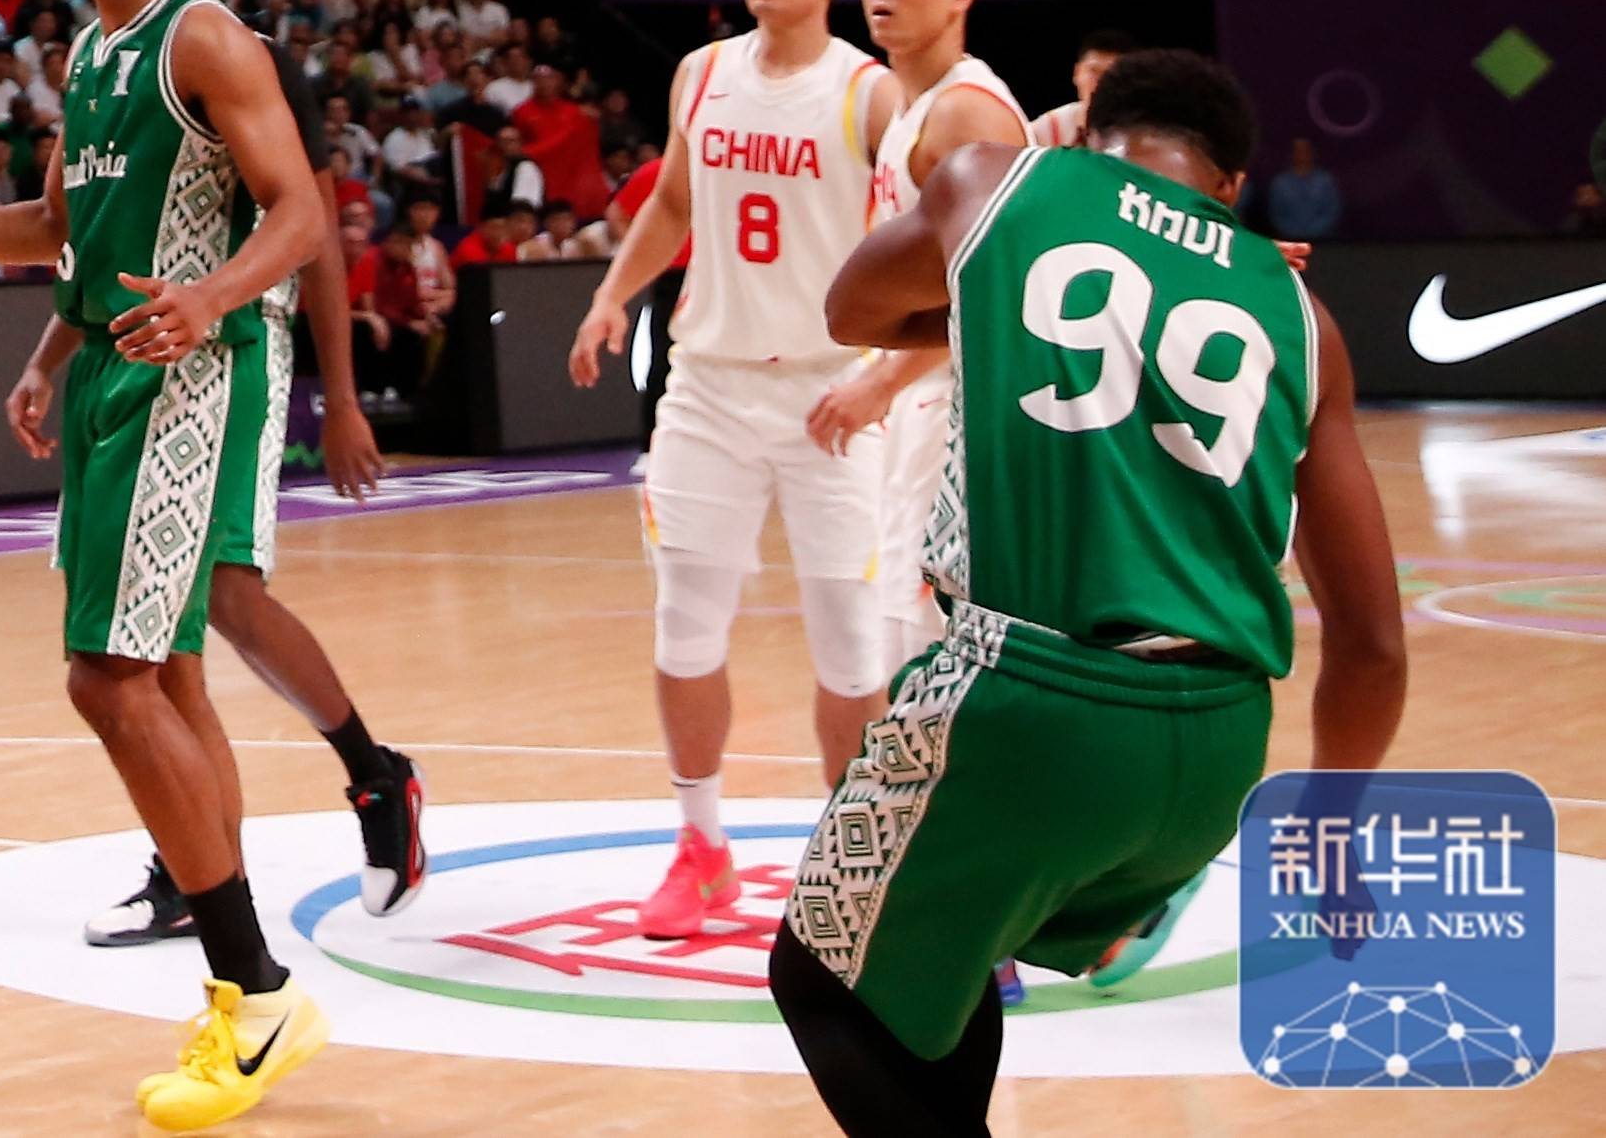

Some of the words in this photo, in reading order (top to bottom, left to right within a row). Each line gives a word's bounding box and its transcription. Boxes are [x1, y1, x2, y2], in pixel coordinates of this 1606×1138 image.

[701, 127, 822, 180] CHINA
[737, 193, 779, 264] 8
[1019, 242, 1276, 489] 99
